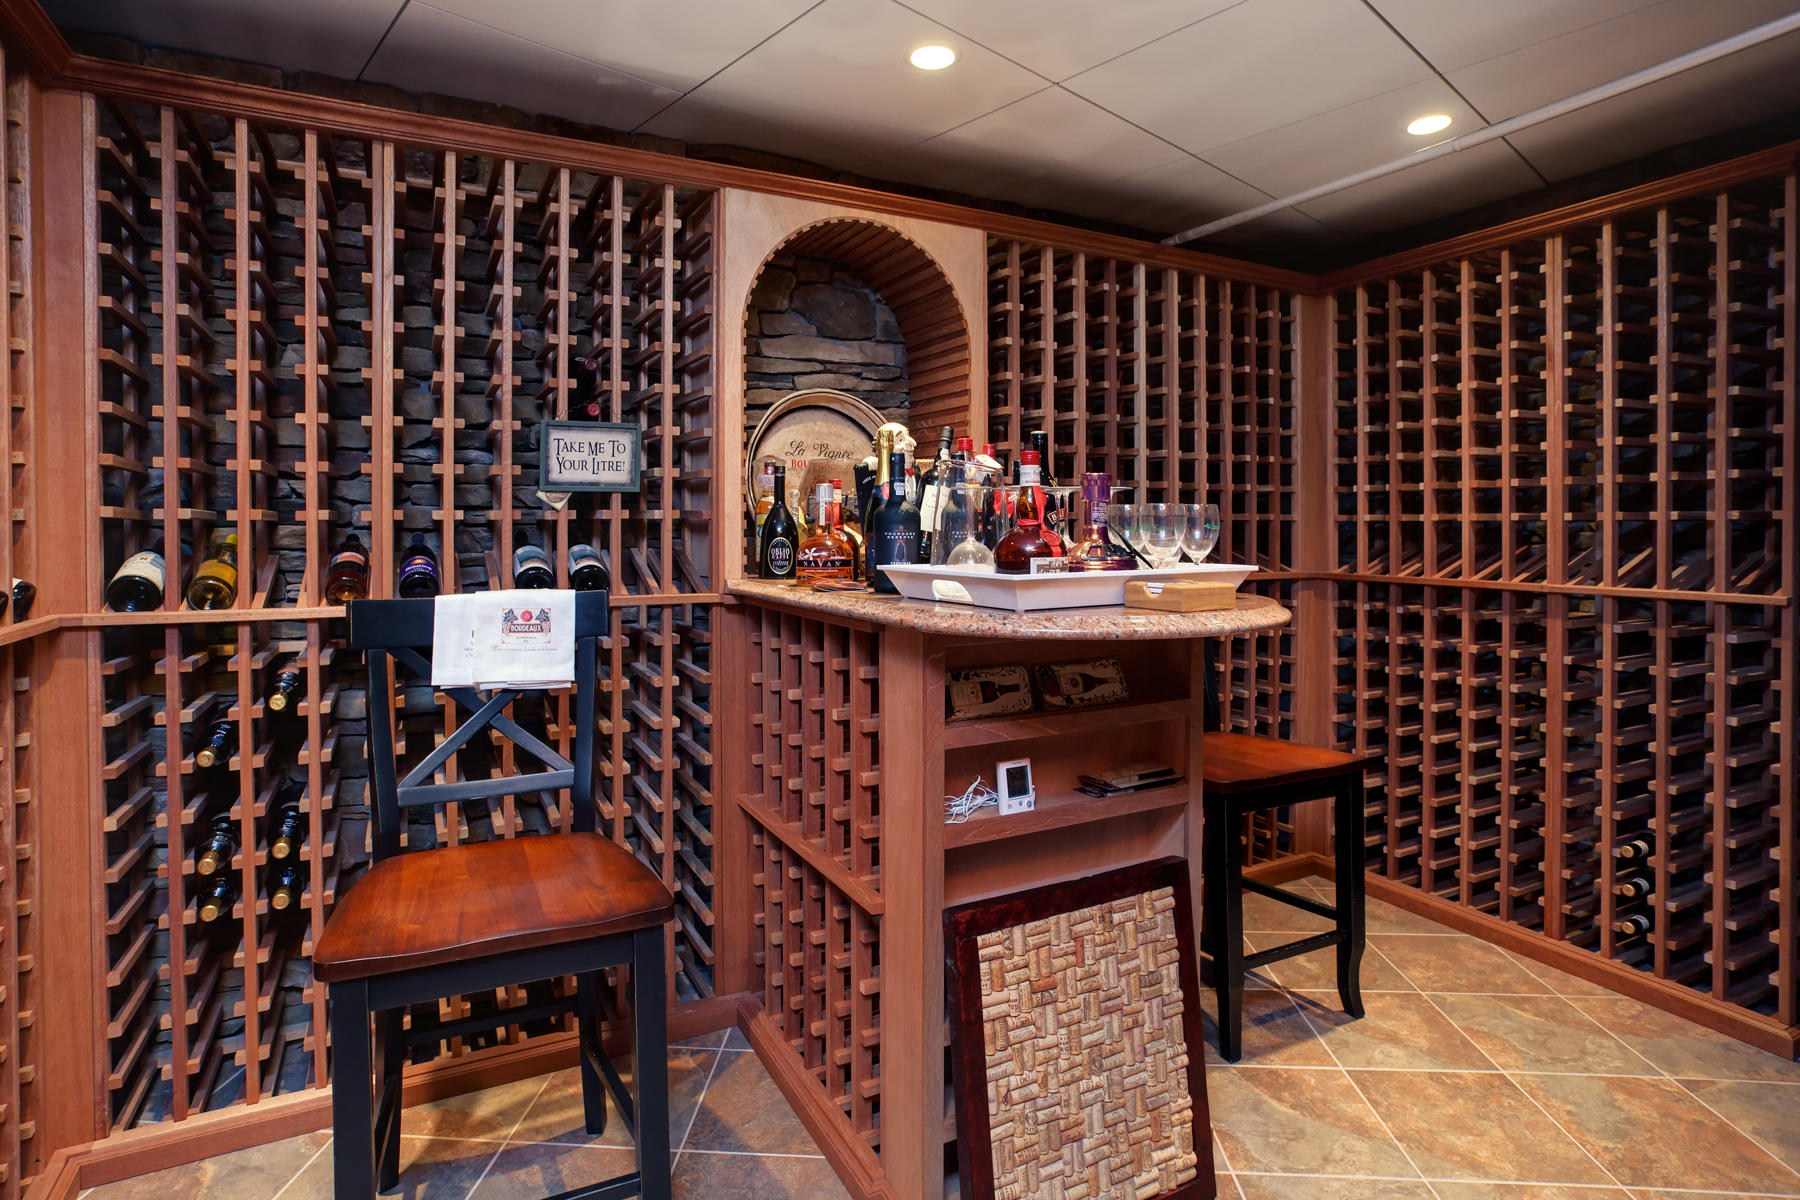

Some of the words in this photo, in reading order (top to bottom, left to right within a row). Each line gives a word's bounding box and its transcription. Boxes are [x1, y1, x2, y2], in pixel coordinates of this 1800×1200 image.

[553, 438, 585, 457] TAKE
[587, 441, 605, 456] ME
[608, 440, 627, 457] TO
[785, 440, 806, 457] La
[556, 457, 588, 474] YOUR
[592, 458, 626, 475] LITRE!
[803, 558, 840, 568] NAVAN
[510, 624, 543, 632] BORDEAUX
